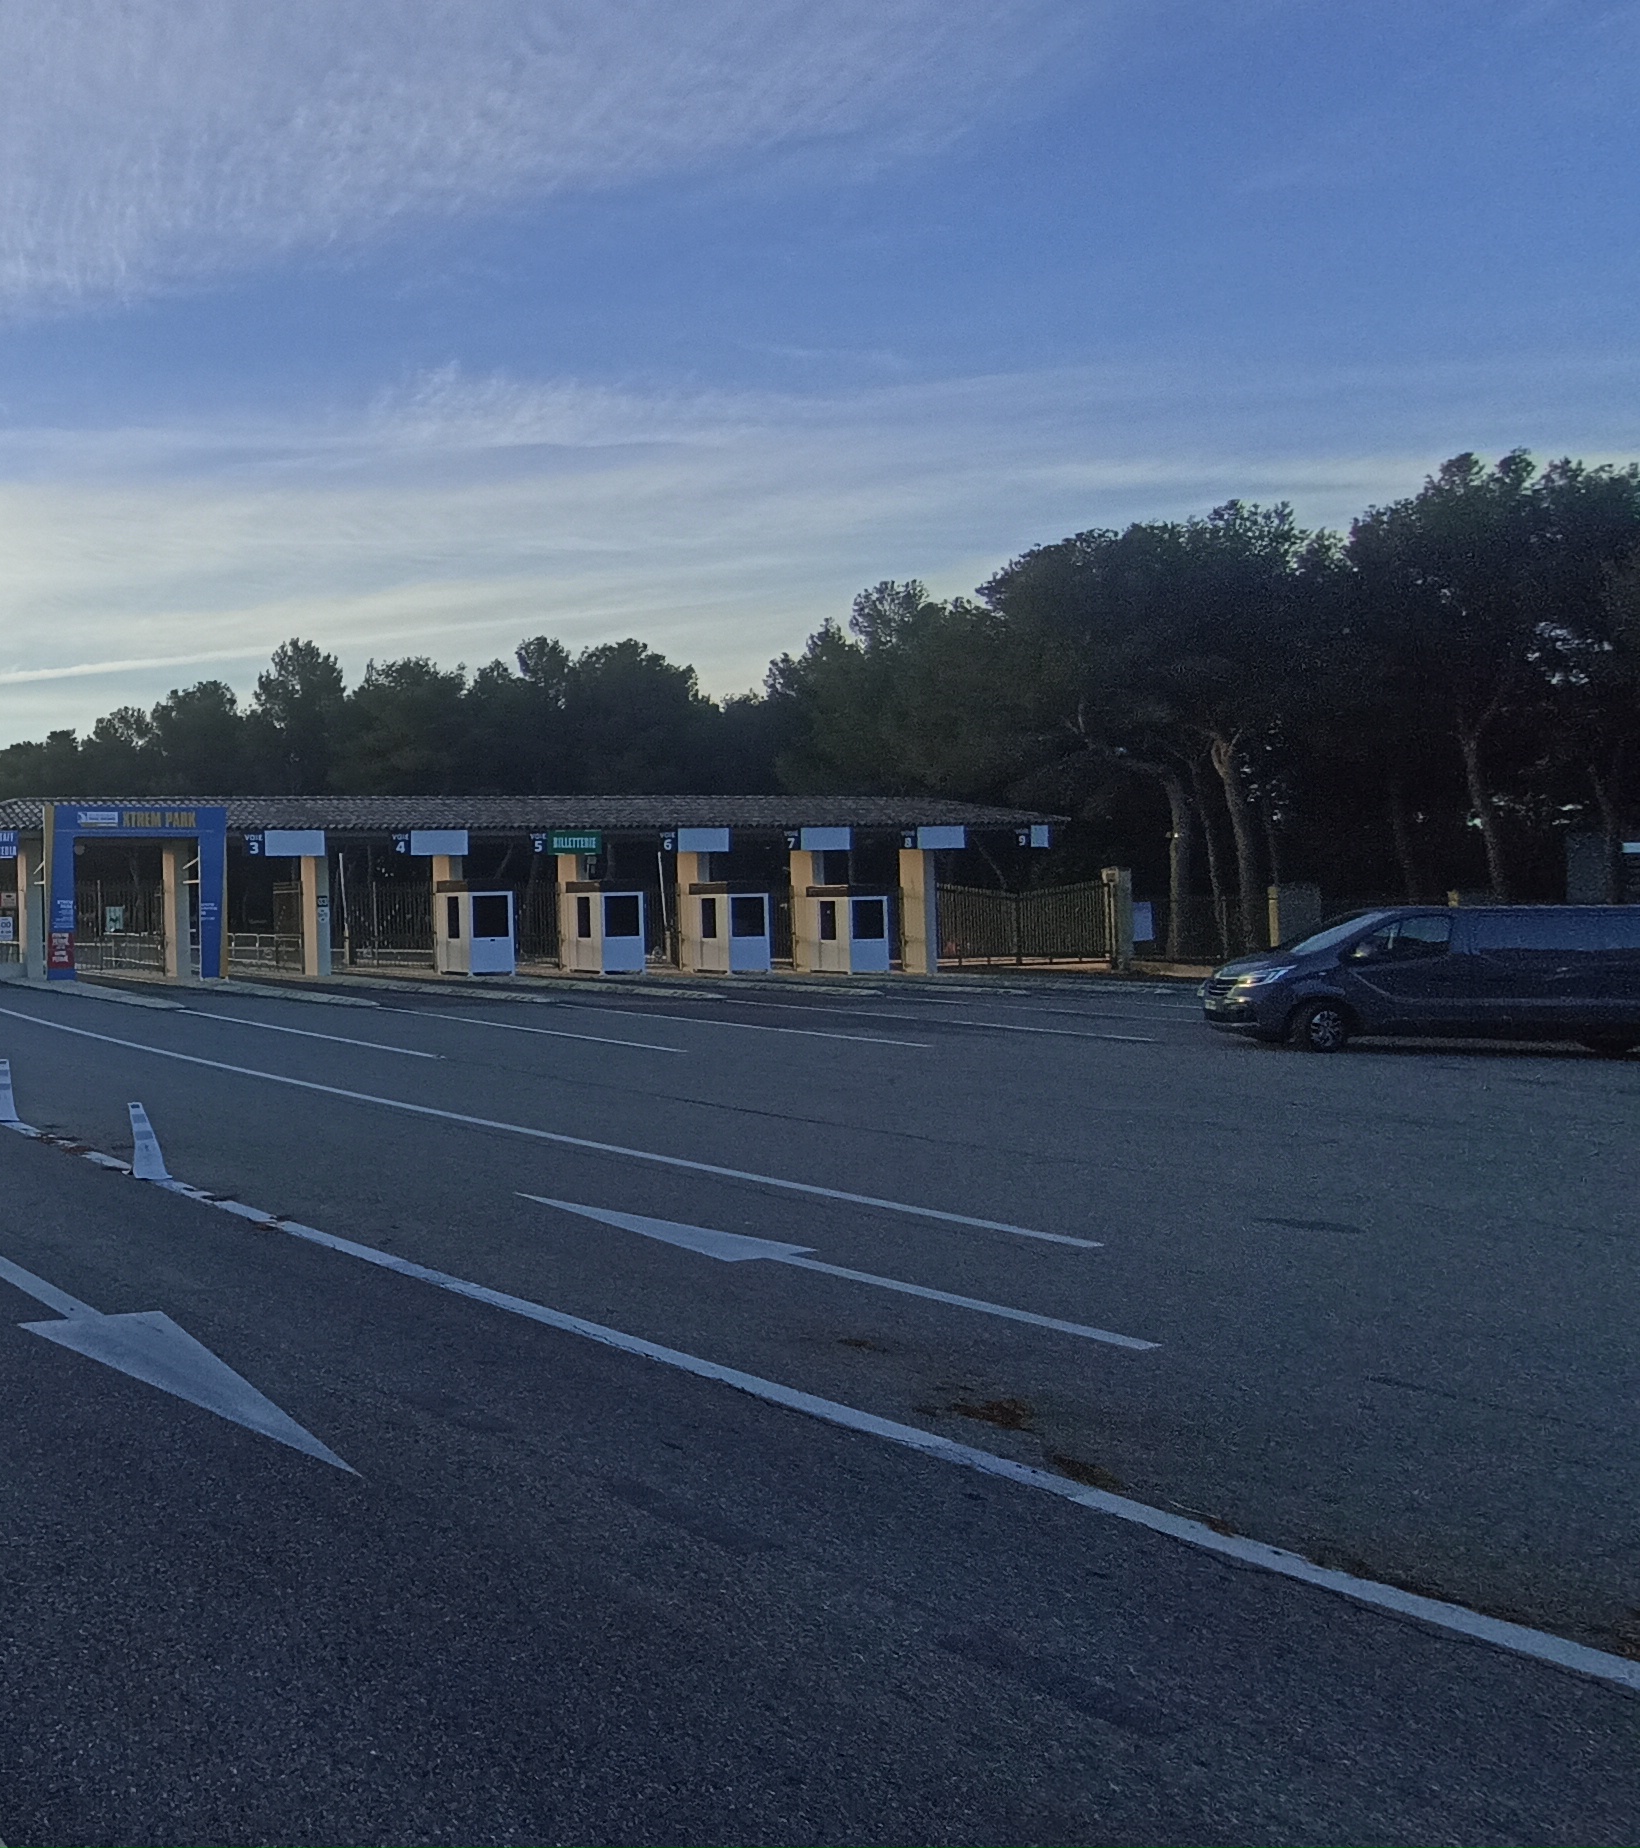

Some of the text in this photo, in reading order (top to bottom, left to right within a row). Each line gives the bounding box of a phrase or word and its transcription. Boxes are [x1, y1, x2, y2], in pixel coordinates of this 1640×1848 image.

[122, 811, 161, 828] XTREM
[165, 811, 196, 828] PARK
[534, 840, 543, 852] 5
[553, 837, 597, 848] BILLETTERIE
[663, 838, 672, 850] 6
[787, 837, 795, 849] 7
[904, 837, 912, 848] 8
[1018, 835, 1026, 846] 9
[249, 841, 259, 854] 3
[395, 841, 406, 853] 4
